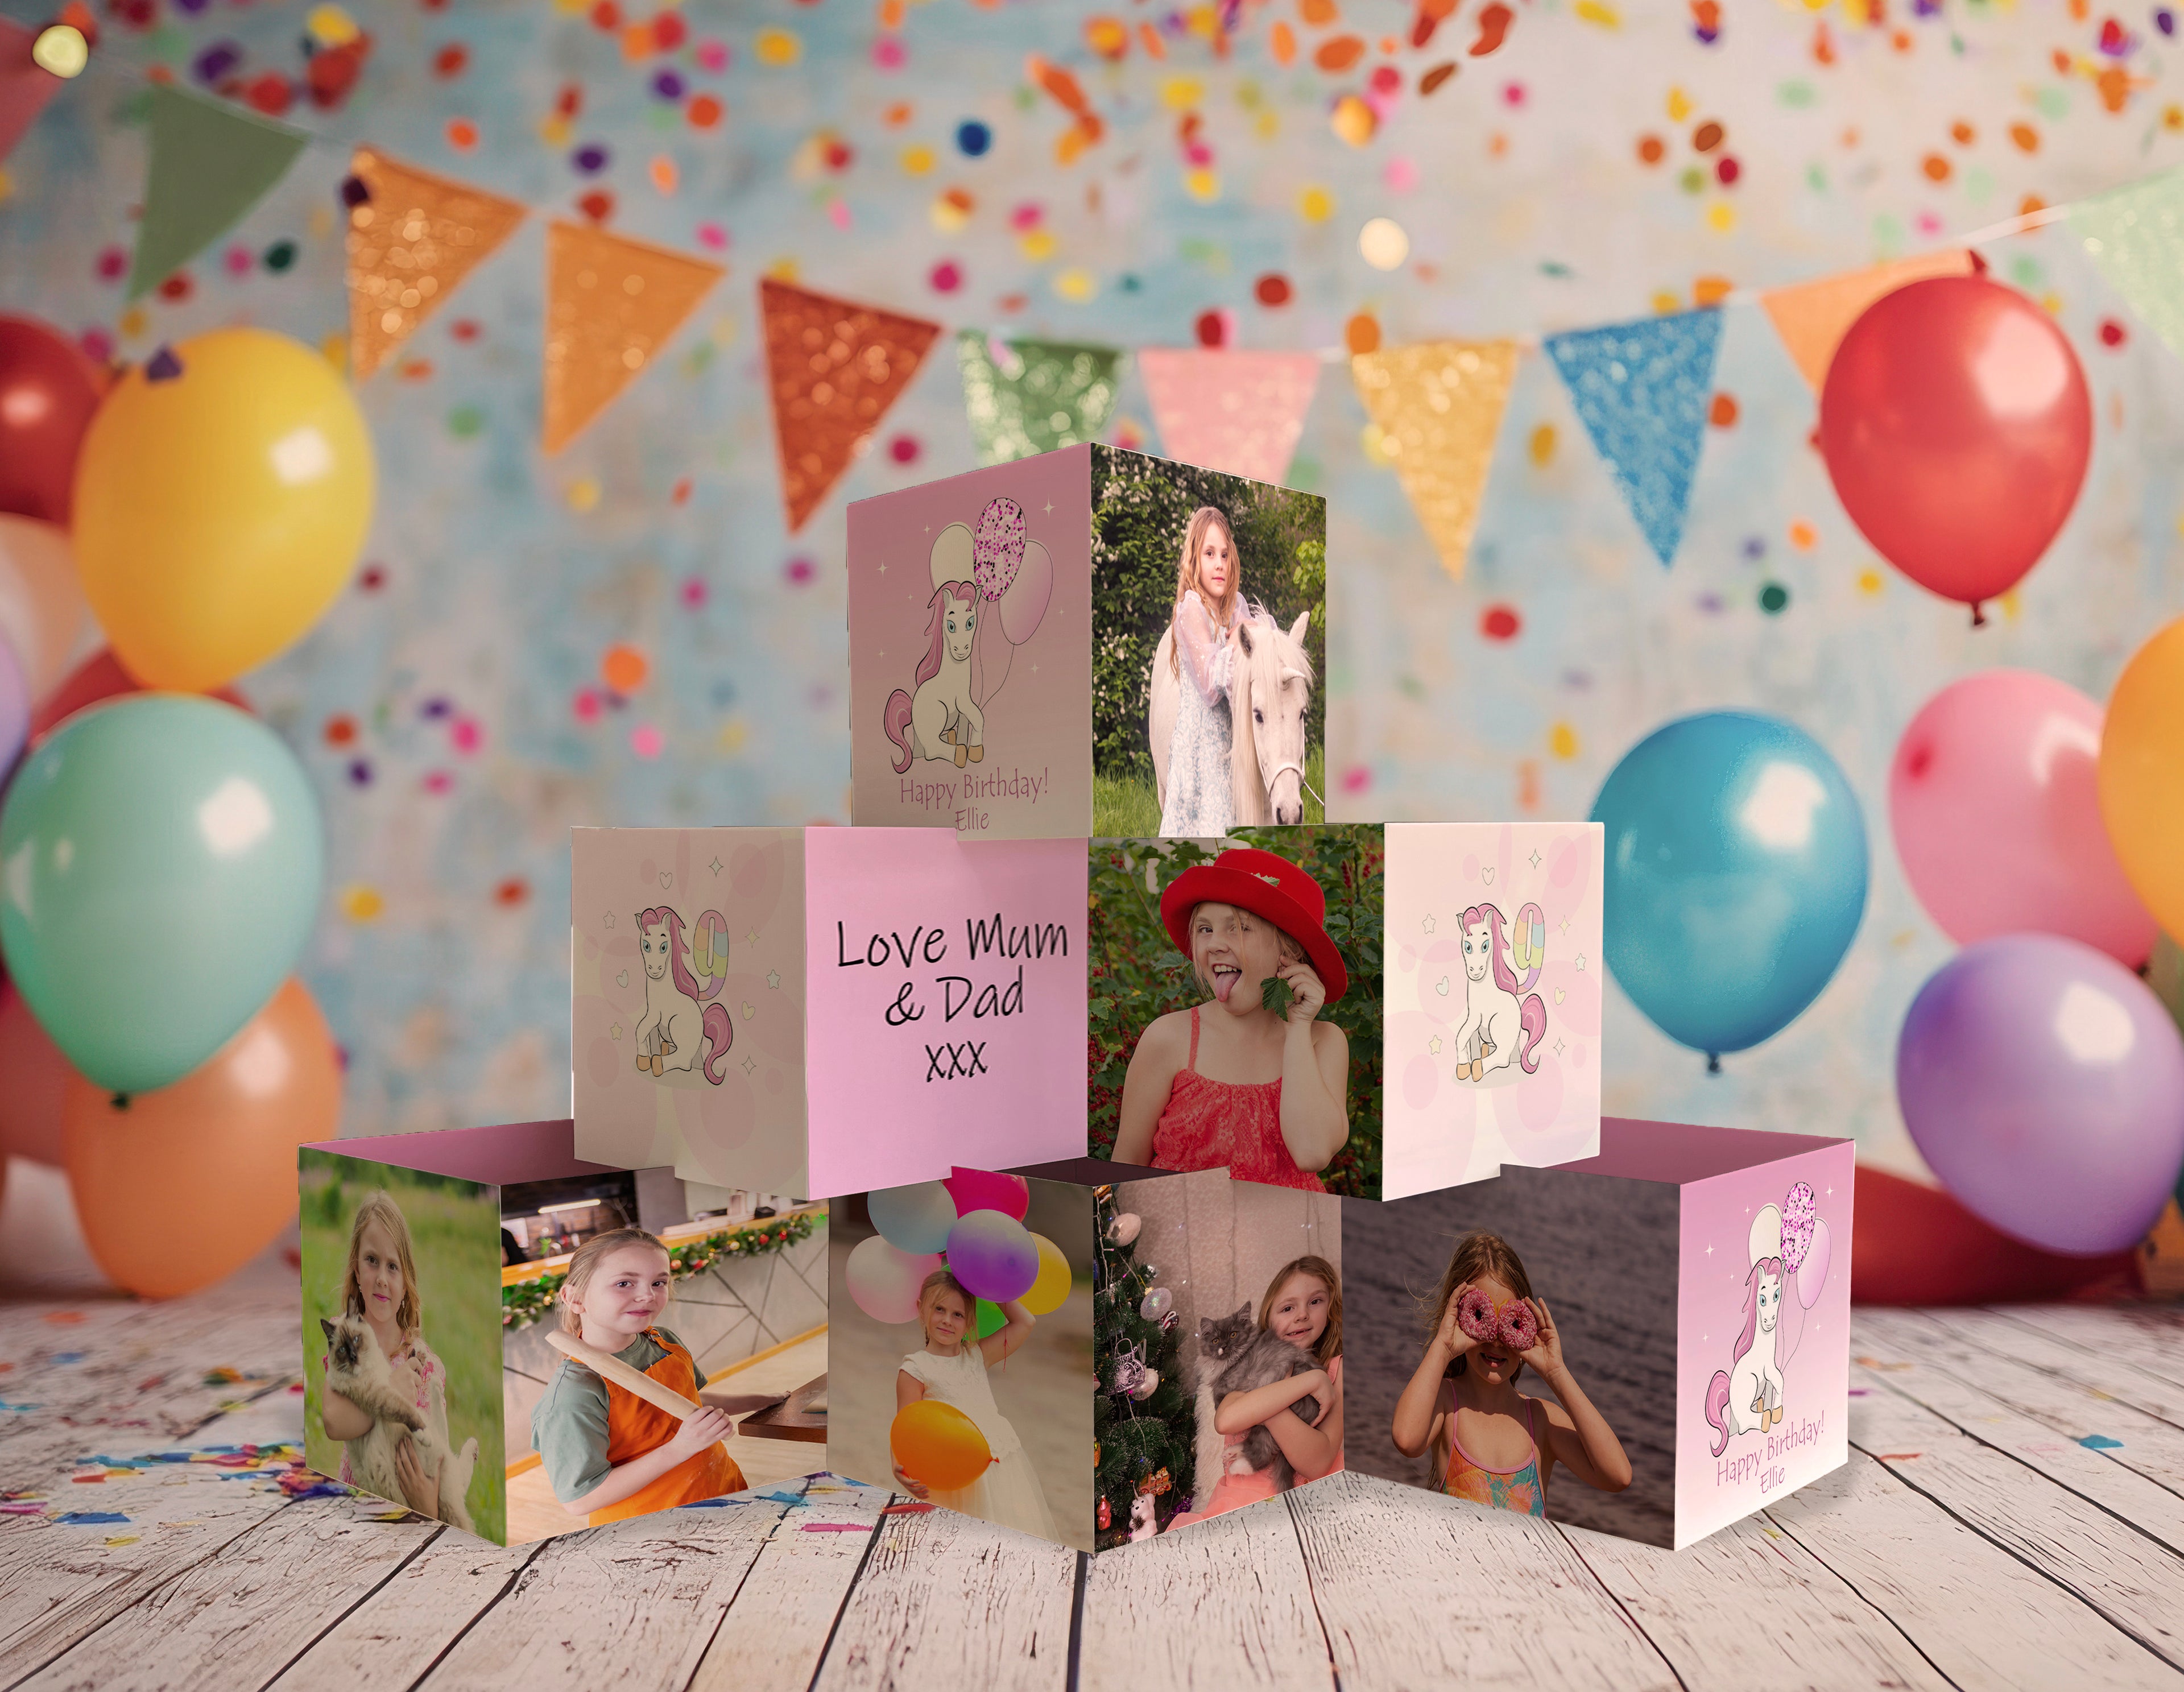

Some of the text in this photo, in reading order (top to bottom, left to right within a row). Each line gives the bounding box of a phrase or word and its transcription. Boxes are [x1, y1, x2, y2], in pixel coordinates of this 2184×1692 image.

[900, 767, 1048, 810] Happy Birthday!
[955, 806, 990, 831] Ellie
[837, 912, 1068, 968] Love Mum
[885, 965, 1024, 1026] & Dad
[1716, 1409, 1825, 1487] Happy Birthday!
[1760, 1465, 1785, 1494] Ellie
